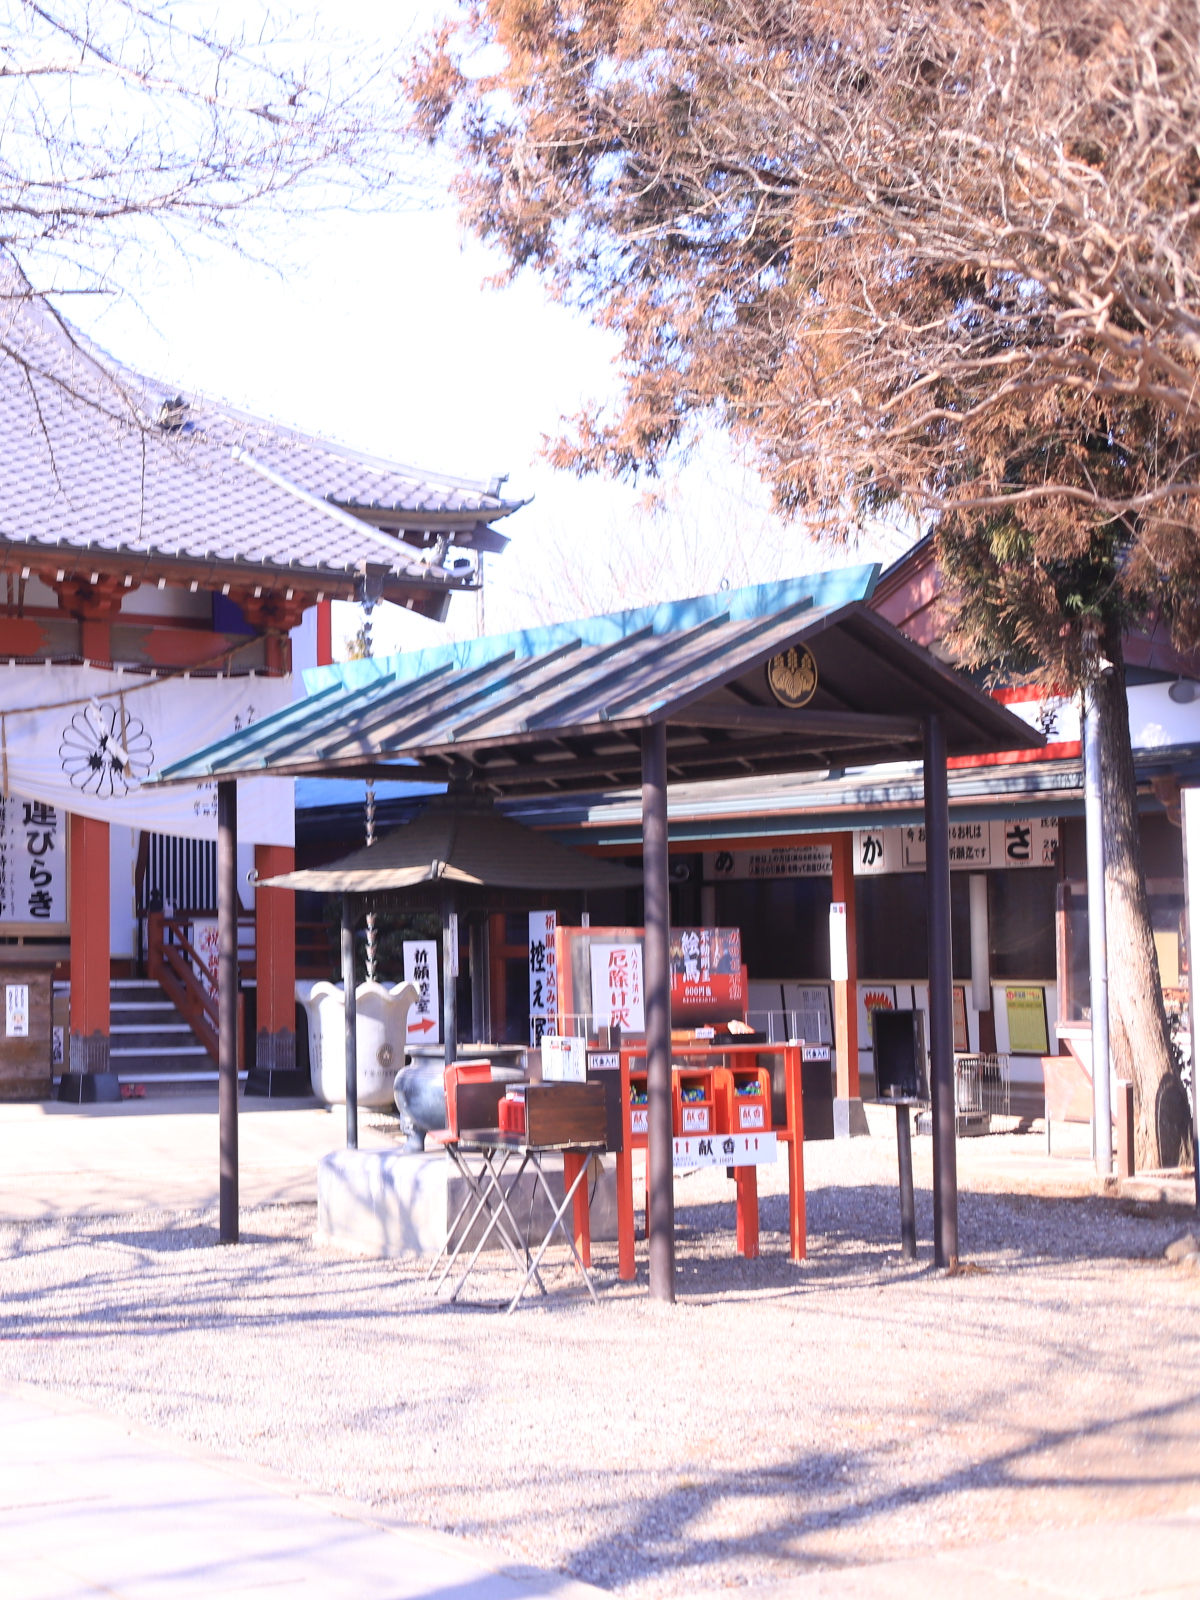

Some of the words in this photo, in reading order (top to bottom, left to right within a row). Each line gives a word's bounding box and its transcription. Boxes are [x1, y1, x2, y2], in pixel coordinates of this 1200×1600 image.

[862, 835, 882, 866] か
[1006, 825, 1030, 860] さ
[715, 851, 734, 873] め
[681, 930, 700, 984] 絵馬
[608, 949, 630, 1029] 厄除け灰
[698, 1138, 735, 1156] 献香
